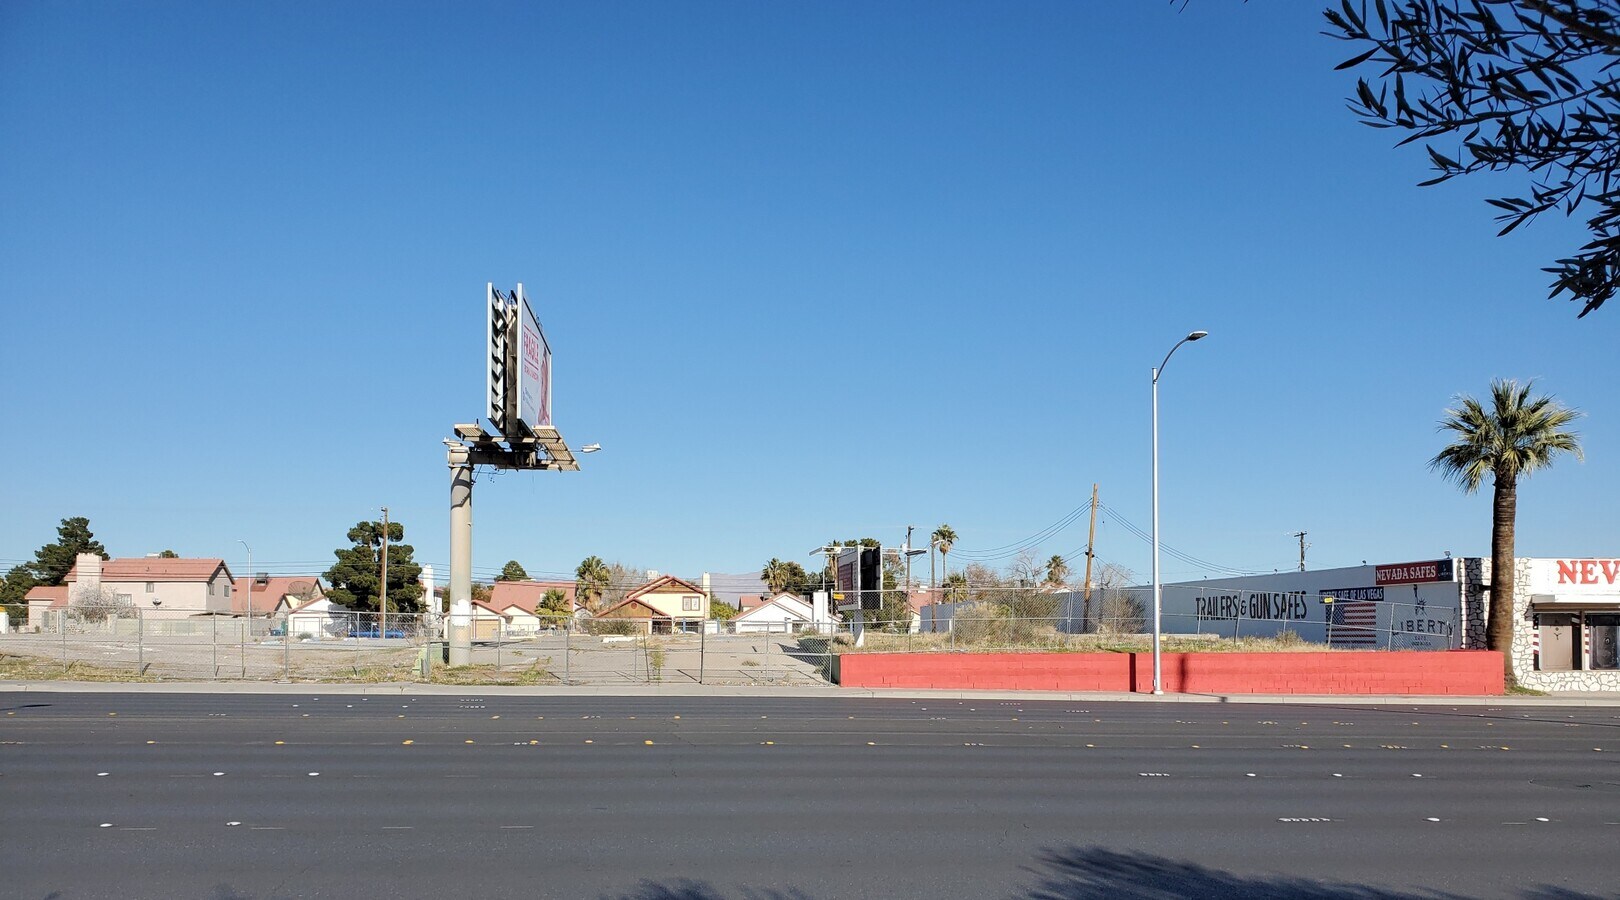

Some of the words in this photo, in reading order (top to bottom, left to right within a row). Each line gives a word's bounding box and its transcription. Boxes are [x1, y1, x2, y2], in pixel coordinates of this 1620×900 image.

[1376, 567, 1409, 581] NEVADA
[1410, 565, 1436, 579] SAFES
[1556, 560, 1620, 584] NEV
[1350, 590, 1357, 600] OF
[1357, 590, 1366, 600] LAS
[1366, 588, 1383, 599] VEGAS
[1195, 595, 1239, 620] TRAILERS
[1240, 600, 1247, 615] &
[1249, 593, 1271, 619] GUN
[1274, 591, 1307, 619] SAFES
